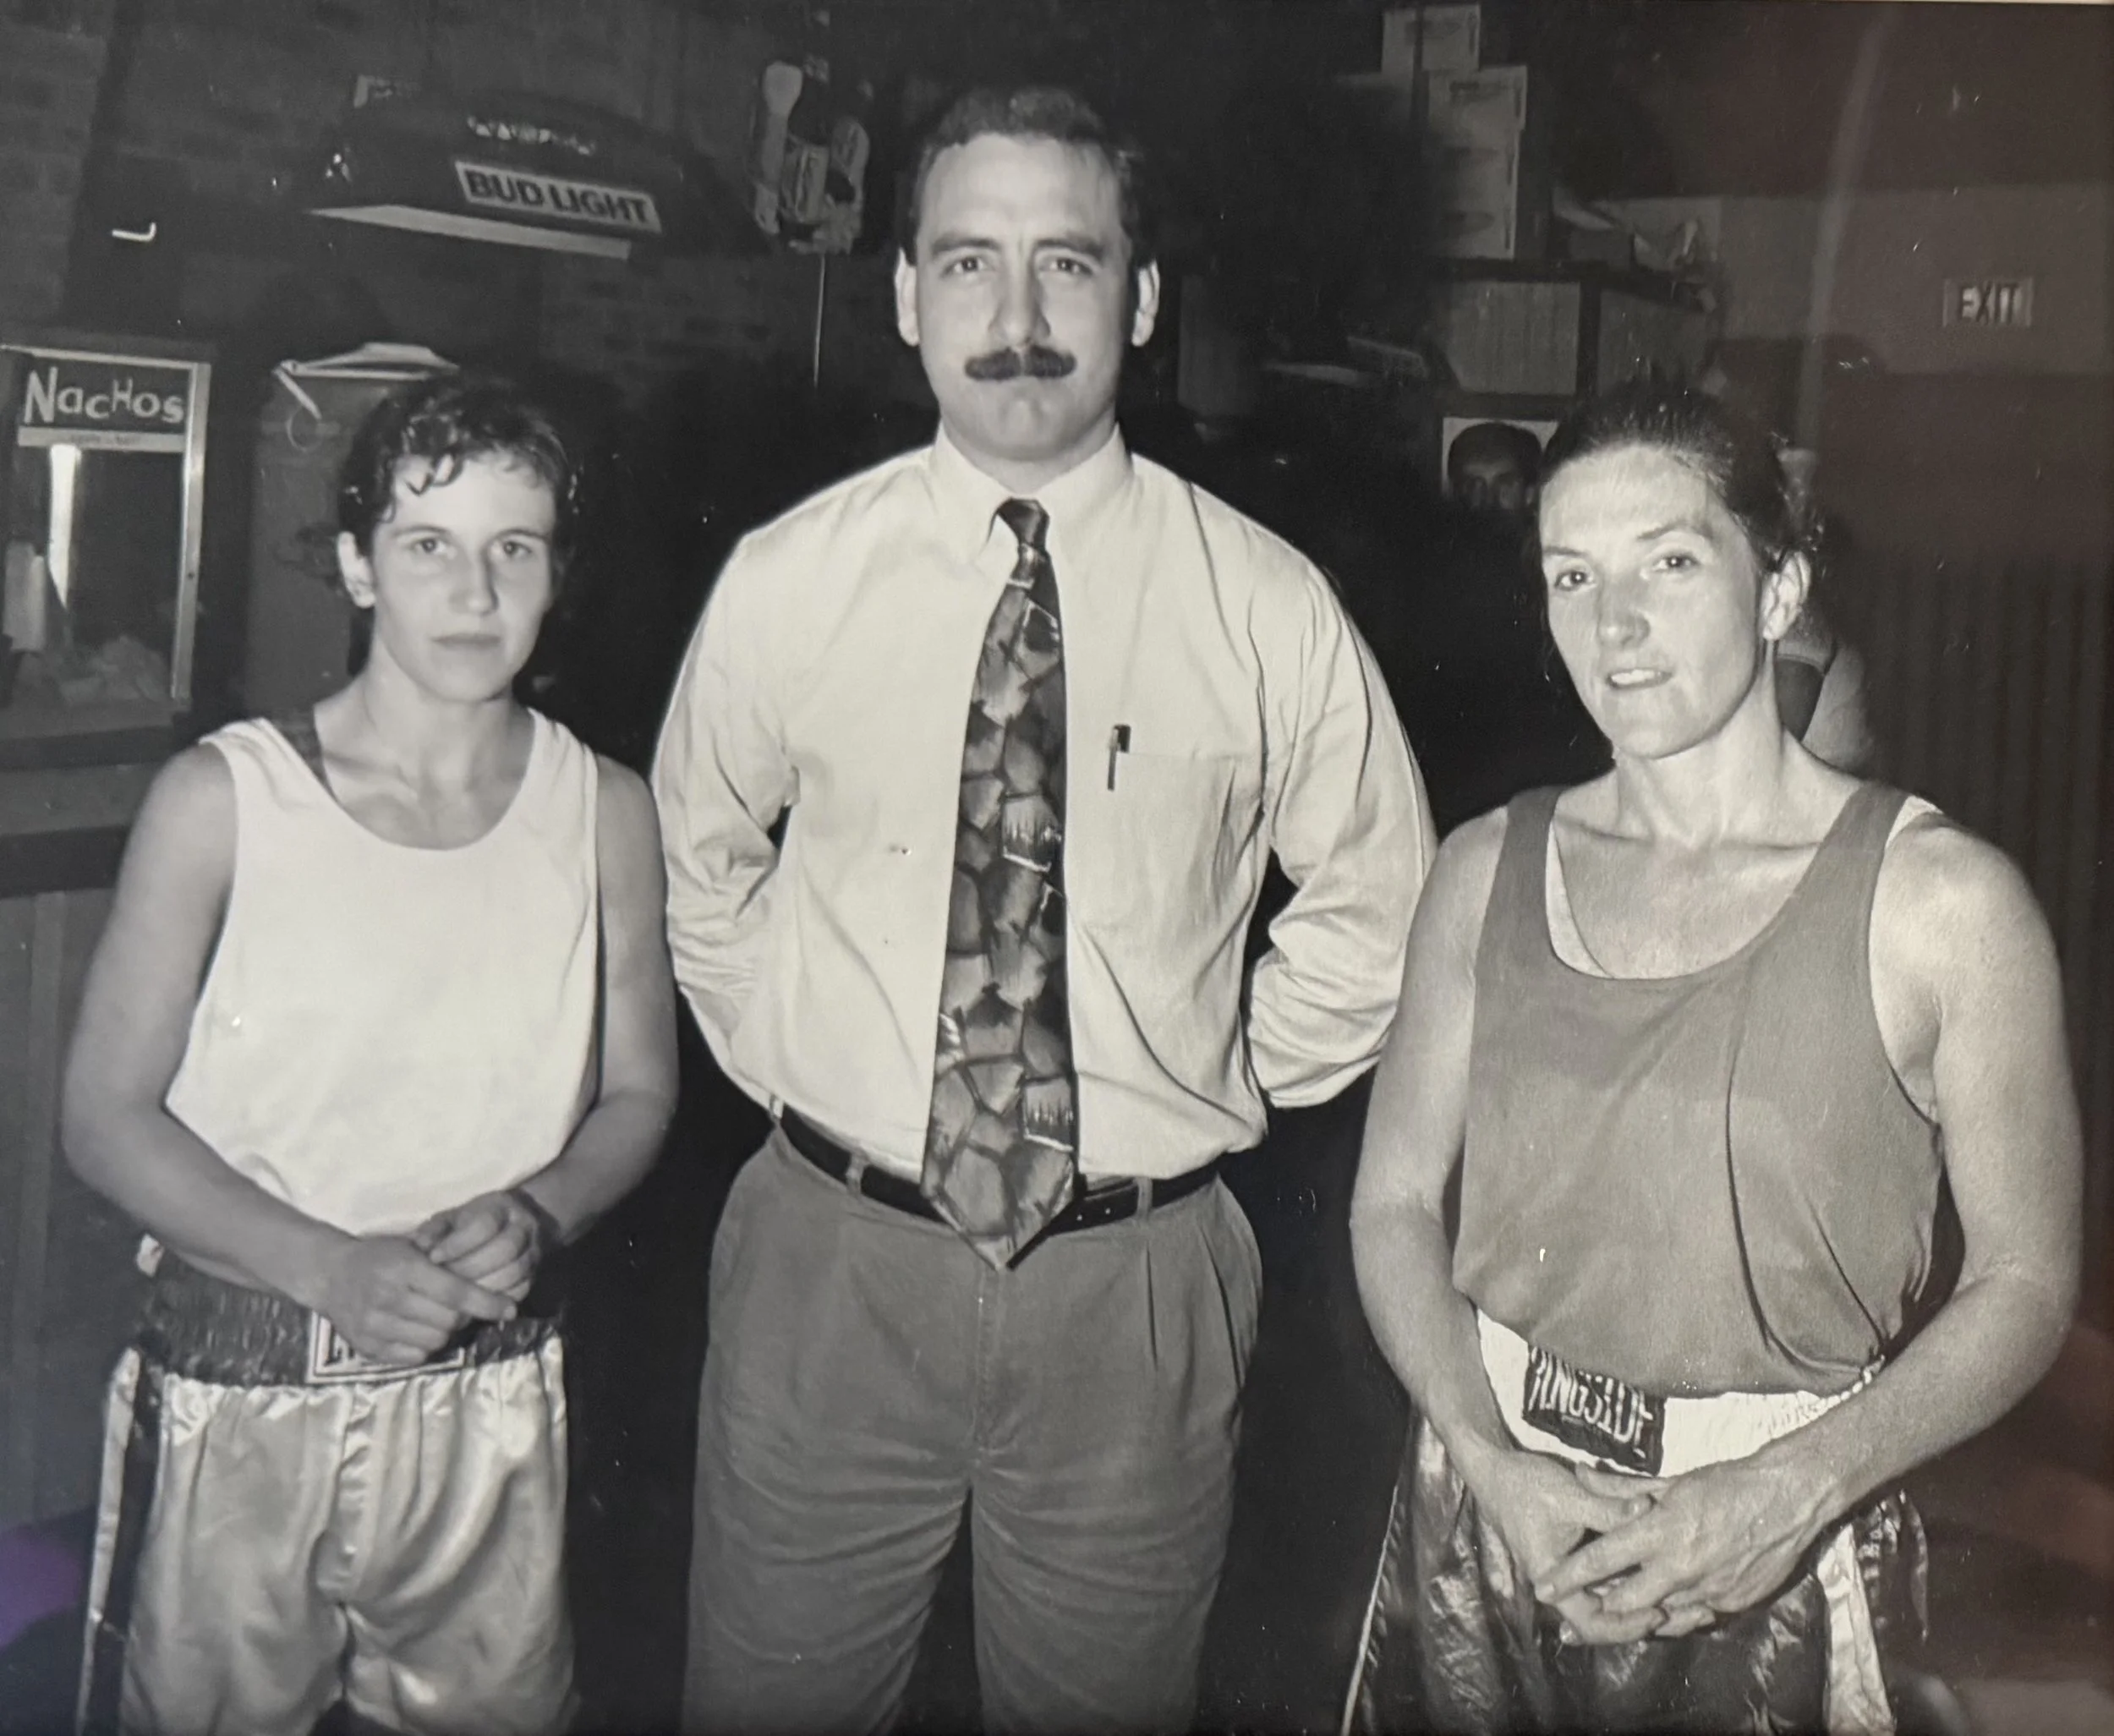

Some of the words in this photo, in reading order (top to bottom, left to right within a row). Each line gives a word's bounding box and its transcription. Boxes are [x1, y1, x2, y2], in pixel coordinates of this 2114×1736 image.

[465, 171, 544, 207] BUD
[551, 180, 649, 224] LIGHT
[1958, 282, 2018, 323] EXIT
